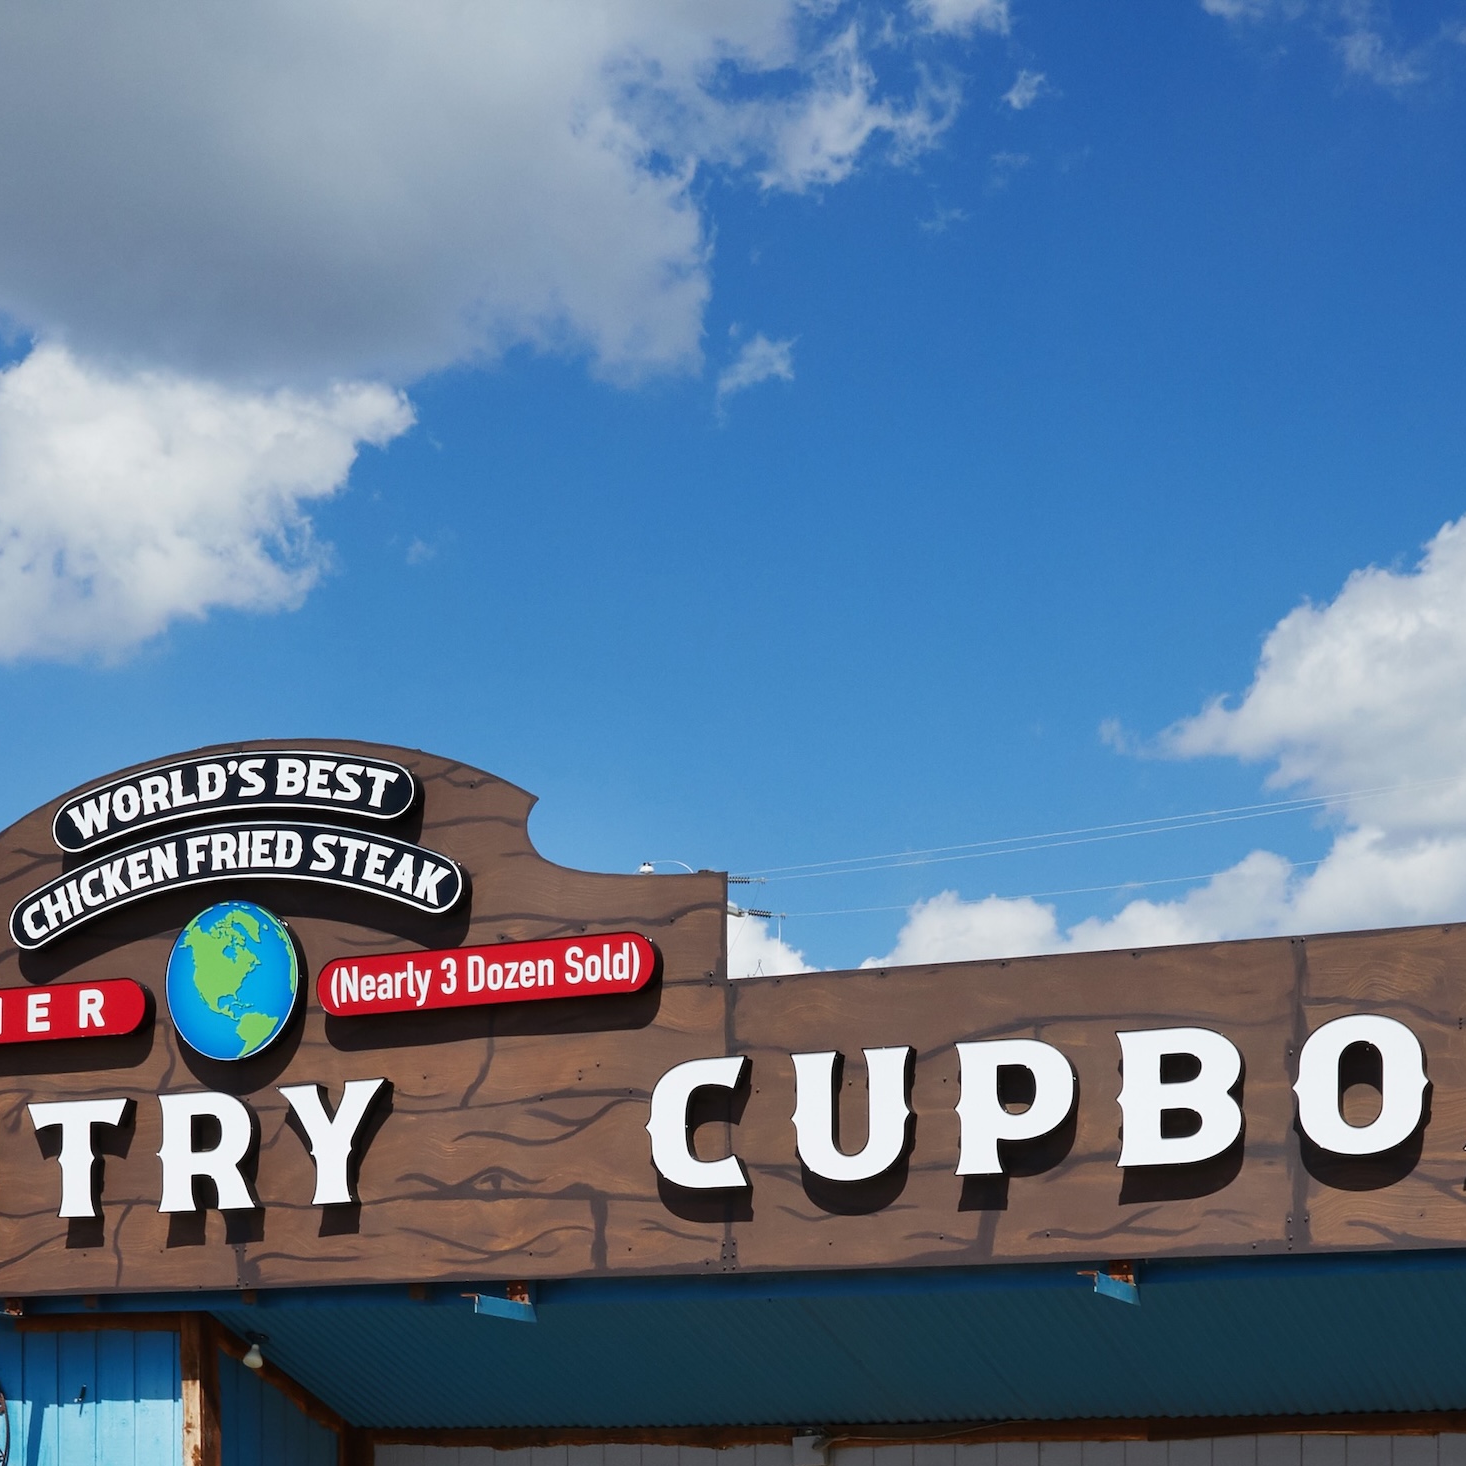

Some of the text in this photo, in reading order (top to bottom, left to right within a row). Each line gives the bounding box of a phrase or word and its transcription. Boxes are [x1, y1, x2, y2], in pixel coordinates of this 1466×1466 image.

[66, 758, 400, 839] WORLD'S BEST
[21, 830, 452, 940] CHICKEN FRIED STEAK
[330, 941, 641, 1008] (Nearly 3 Dozen Sold)
